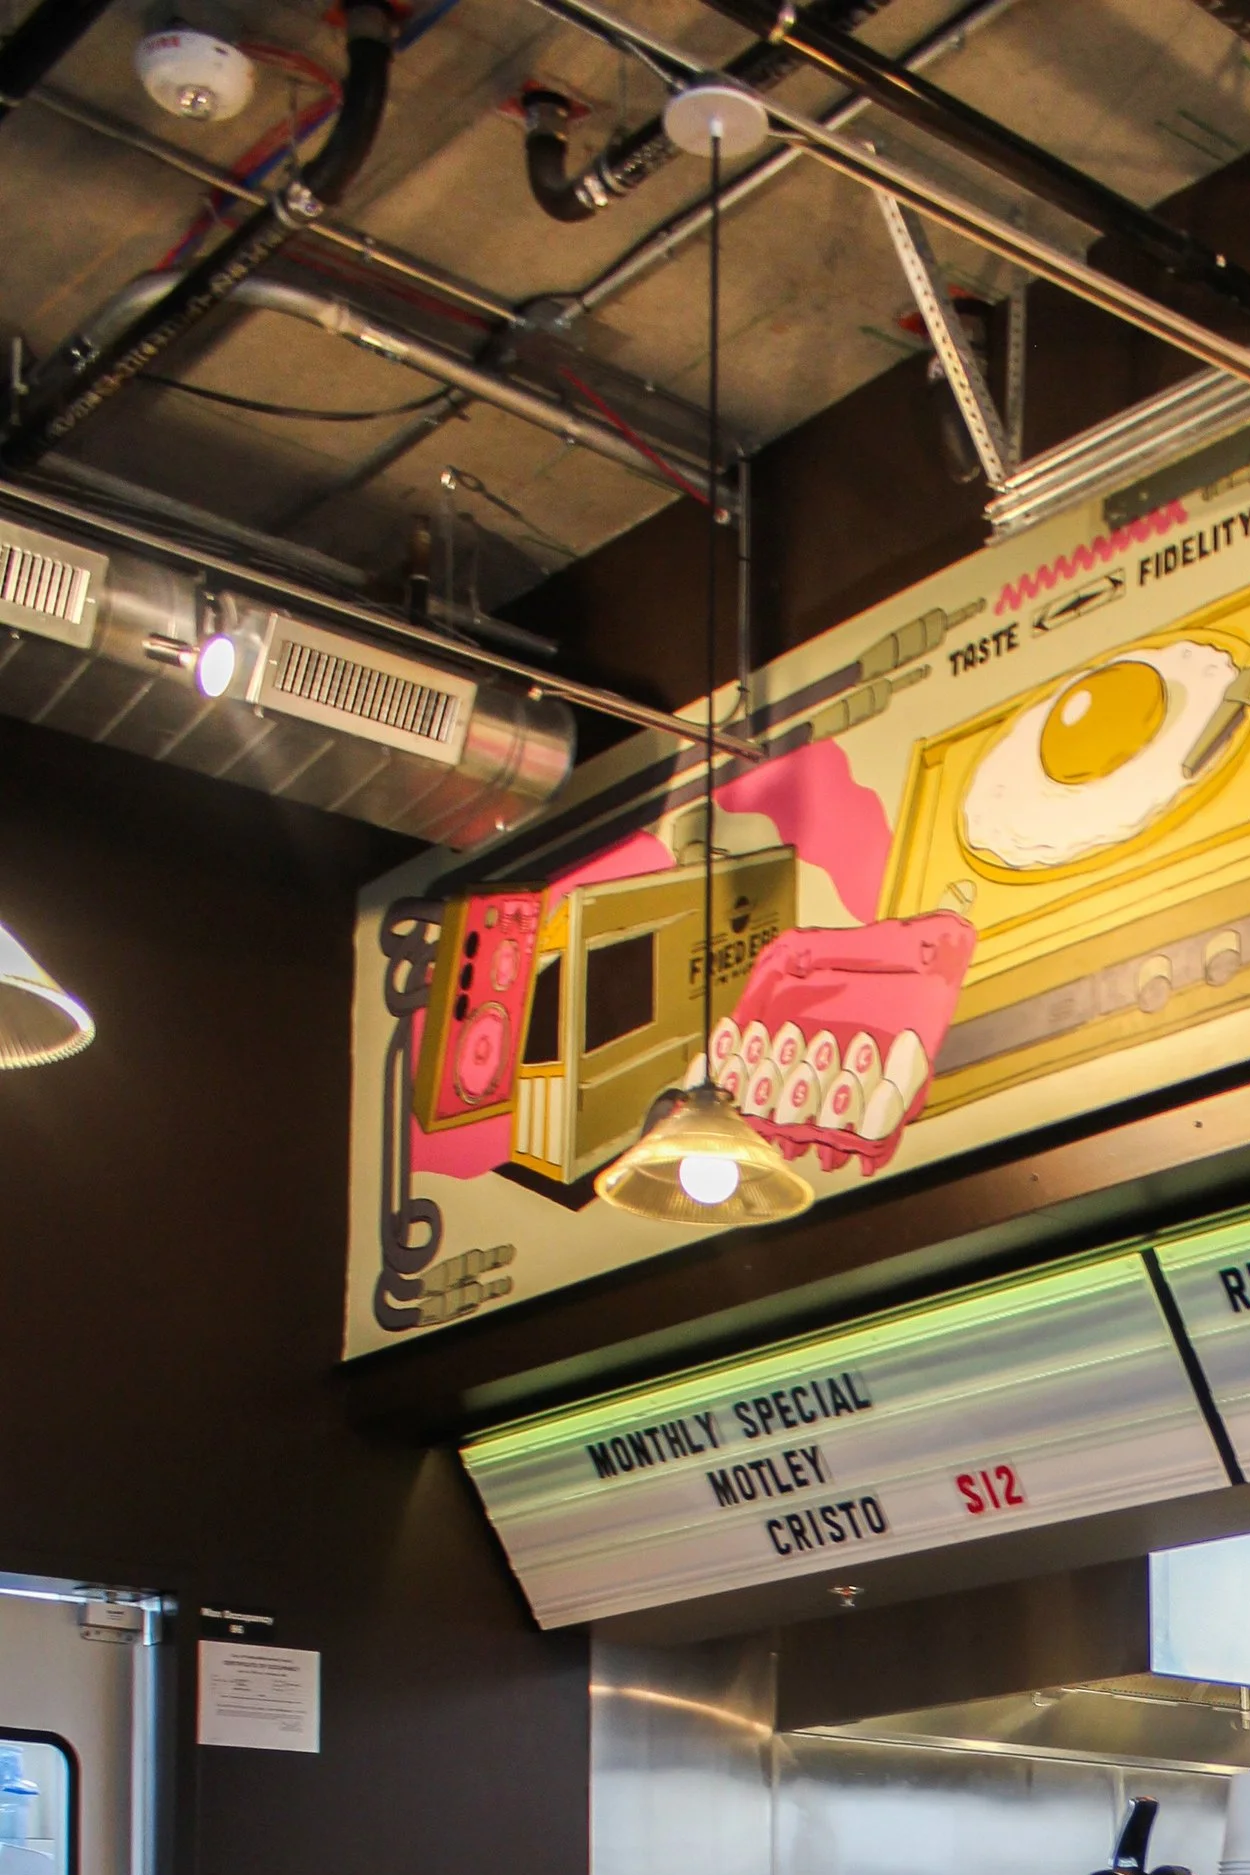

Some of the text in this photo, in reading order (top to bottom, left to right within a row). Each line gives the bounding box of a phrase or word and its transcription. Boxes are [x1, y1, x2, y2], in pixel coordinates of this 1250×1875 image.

[950, 622, 1020, 676] TASTE
[586, 1373, 872, 1479] MONTHLY SPECIAL
[707, 1445, 828, 1507] MOTLEY
[765, 1497, 887, 1556] CRISTO
